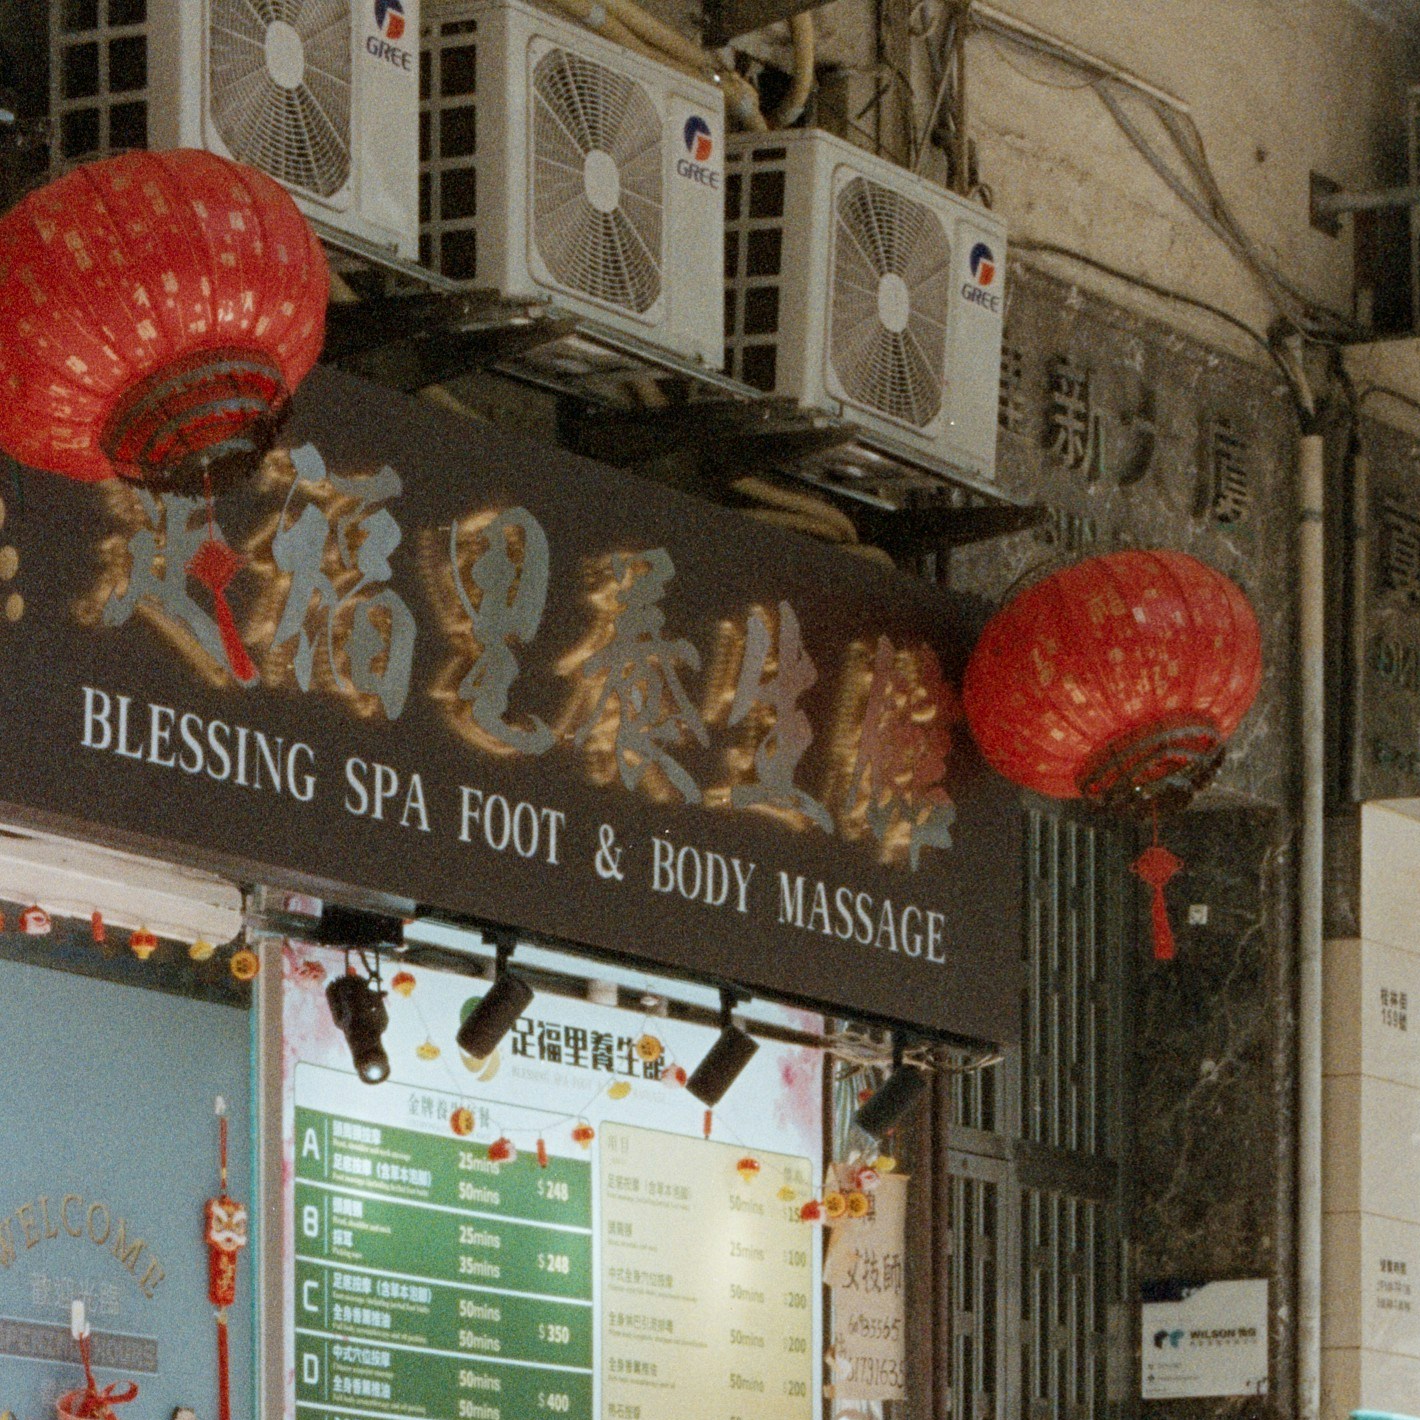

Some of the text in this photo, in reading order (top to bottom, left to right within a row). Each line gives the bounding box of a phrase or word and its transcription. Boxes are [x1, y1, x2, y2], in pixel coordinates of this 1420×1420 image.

[365, 35, 412, 72] GREE
[676, 159, 721, 190] GREE
[81, 687, 946, 964] BLESSING SPA FOOT & BODY MASSAGE
[302, 1127, 320, 1160] A
[459, 1182, 500, 1205] 50mins
[303, 1205, 319, 1238] B
[459, 1225, 500, 1249] 25mins
[459, 1255, 500, 1279] 35mins
[303, 1280, 319, 1313] C
[459, 1300, 500, 1322] 50mins
[459, 1329, 500, 1351] 50mins
[303, 1353, 319, 1386] D
[459, 1370, 500, 1391] 50mins
